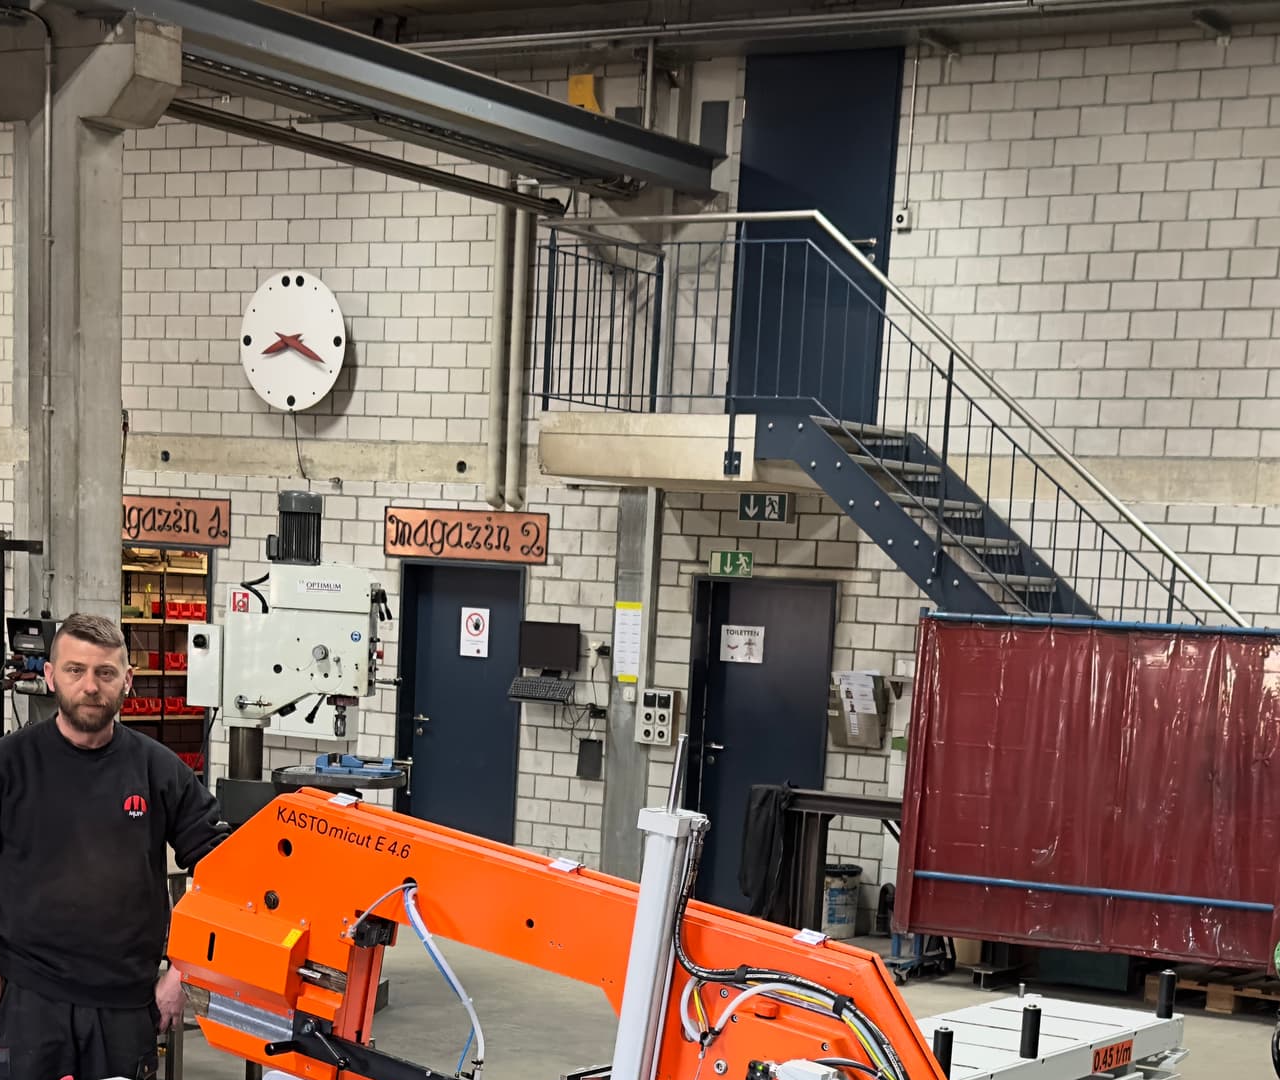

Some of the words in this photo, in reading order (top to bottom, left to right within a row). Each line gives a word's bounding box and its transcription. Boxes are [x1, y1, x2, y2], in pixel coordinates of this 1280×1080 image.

[520, 521, 544, 556] 2
[306, 581, 341, 590] OPTIMUM
[726, 628, 760, 637] TOILETTEN
[276, 805, 373, 849] KASTOmicut
[374, 835, 388, 852] E
[387, 841, 411, 859] 4.6
[1093, 1047, 1115, 1071] 0.45
[1115, 1044, 1132, 1065] t/m
